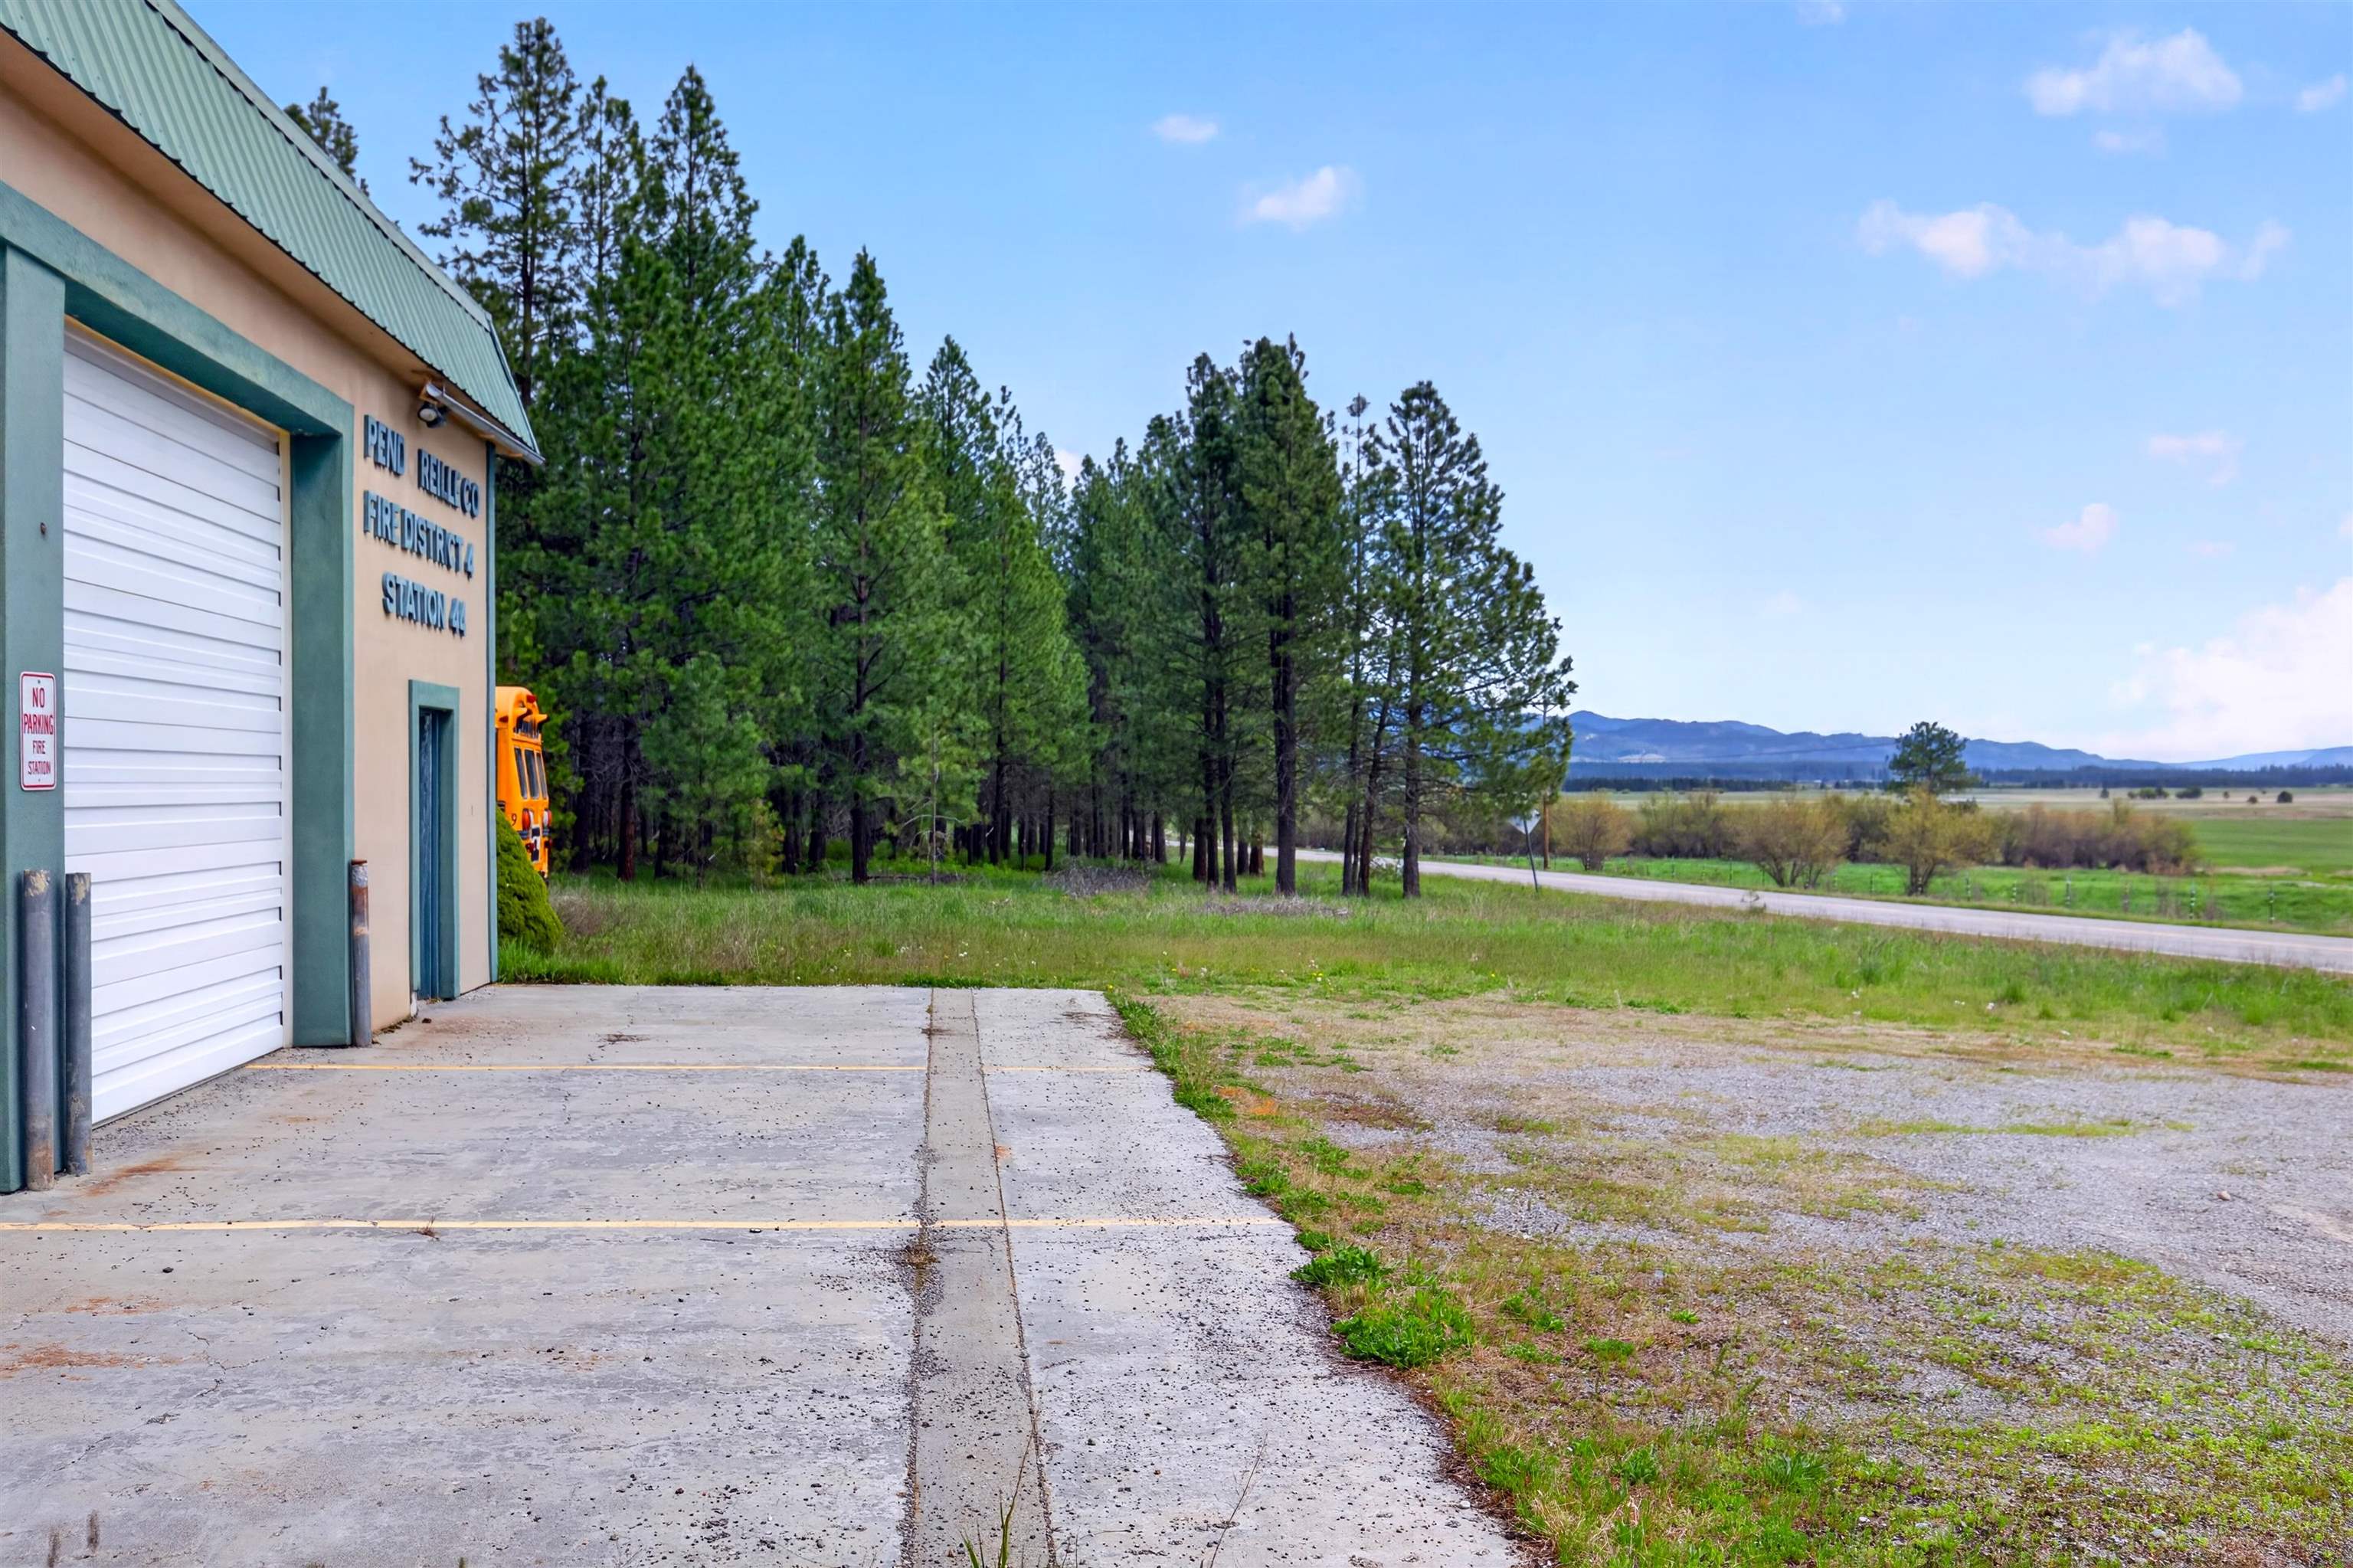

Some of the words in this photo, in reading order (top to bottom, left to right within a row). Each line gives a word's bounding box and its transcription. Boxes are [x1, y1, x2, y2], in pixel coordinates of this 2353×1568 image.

[364, 414, 404, 476] PEND
[460, 476, 479, 519] CO
[363, 489, 400, 545] FIRE
[464, 543, 474, 580] 4
[382, 571, 444, 631] STATION
[449, 598, 466, 637] 44
[32, 688, 45, 708] NO
[24, 713, 54, 735] PARKING
[32, 740, 46, 755] FIRE
[28, 761, 51, 775] STATION
